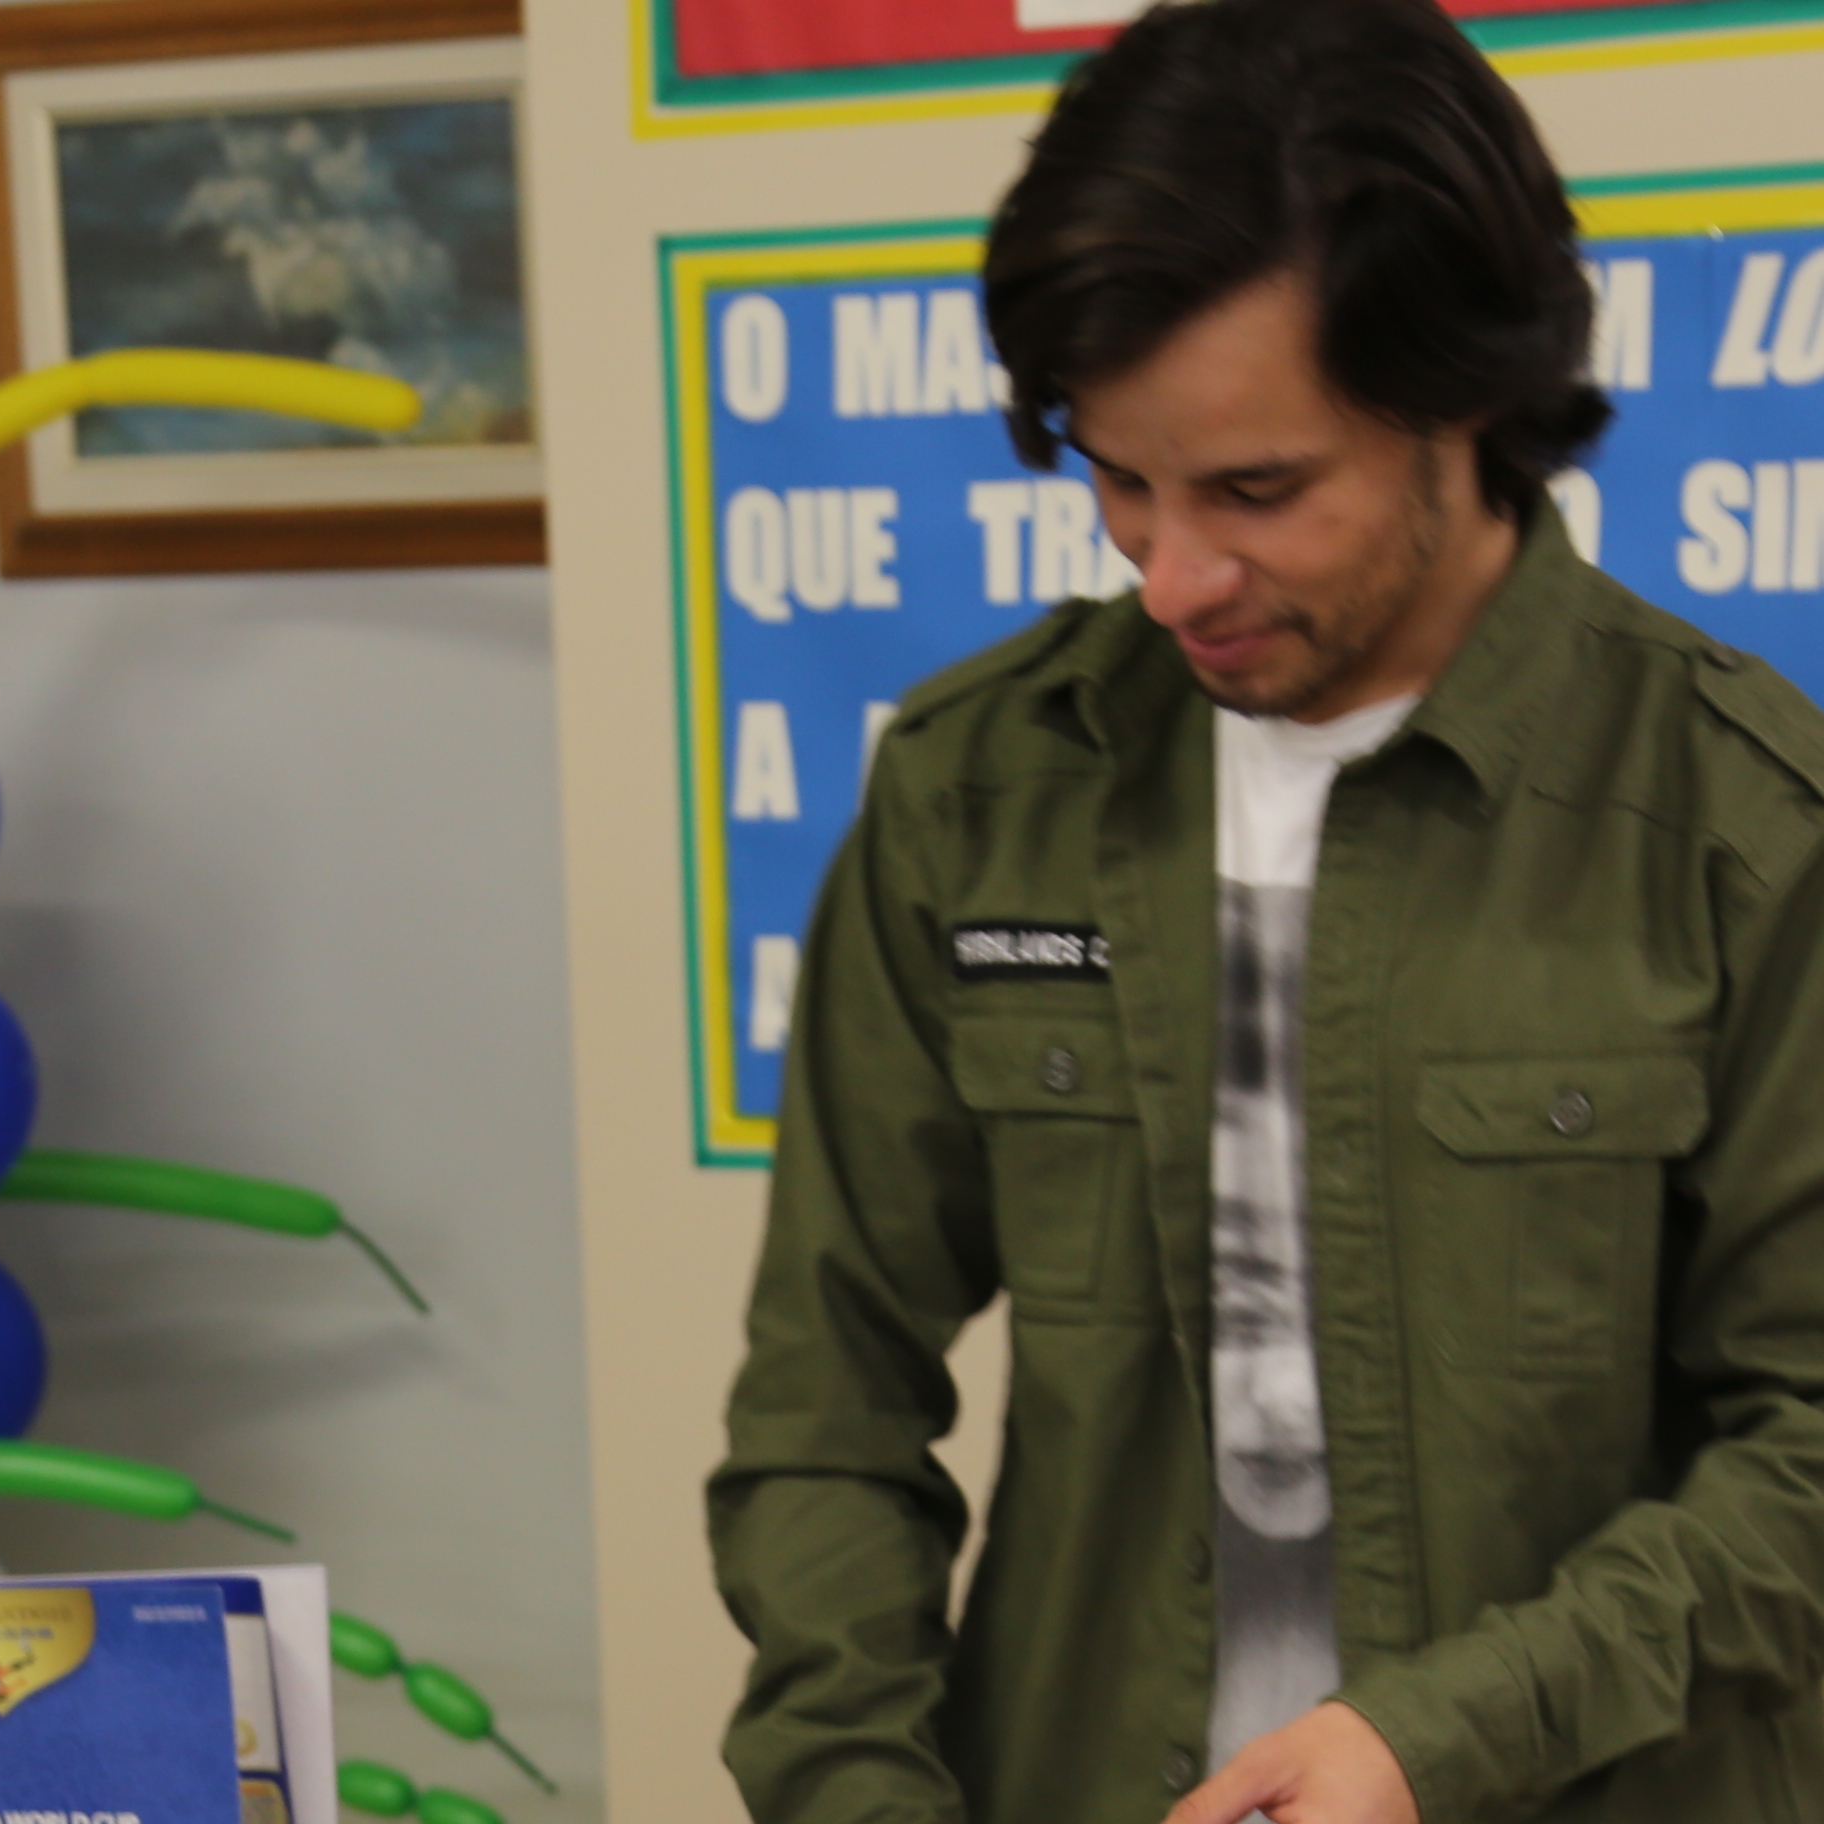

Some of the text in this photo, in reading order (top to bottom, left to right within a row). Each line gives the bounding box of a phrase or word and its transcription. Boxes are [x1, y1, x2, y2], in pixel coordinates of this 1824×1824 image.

[722, 294, 788, 423] O
[832, 288, 1014, 418] MA
[726, 486, 900, 624] QUE
[732, 701, 801, 821] A
